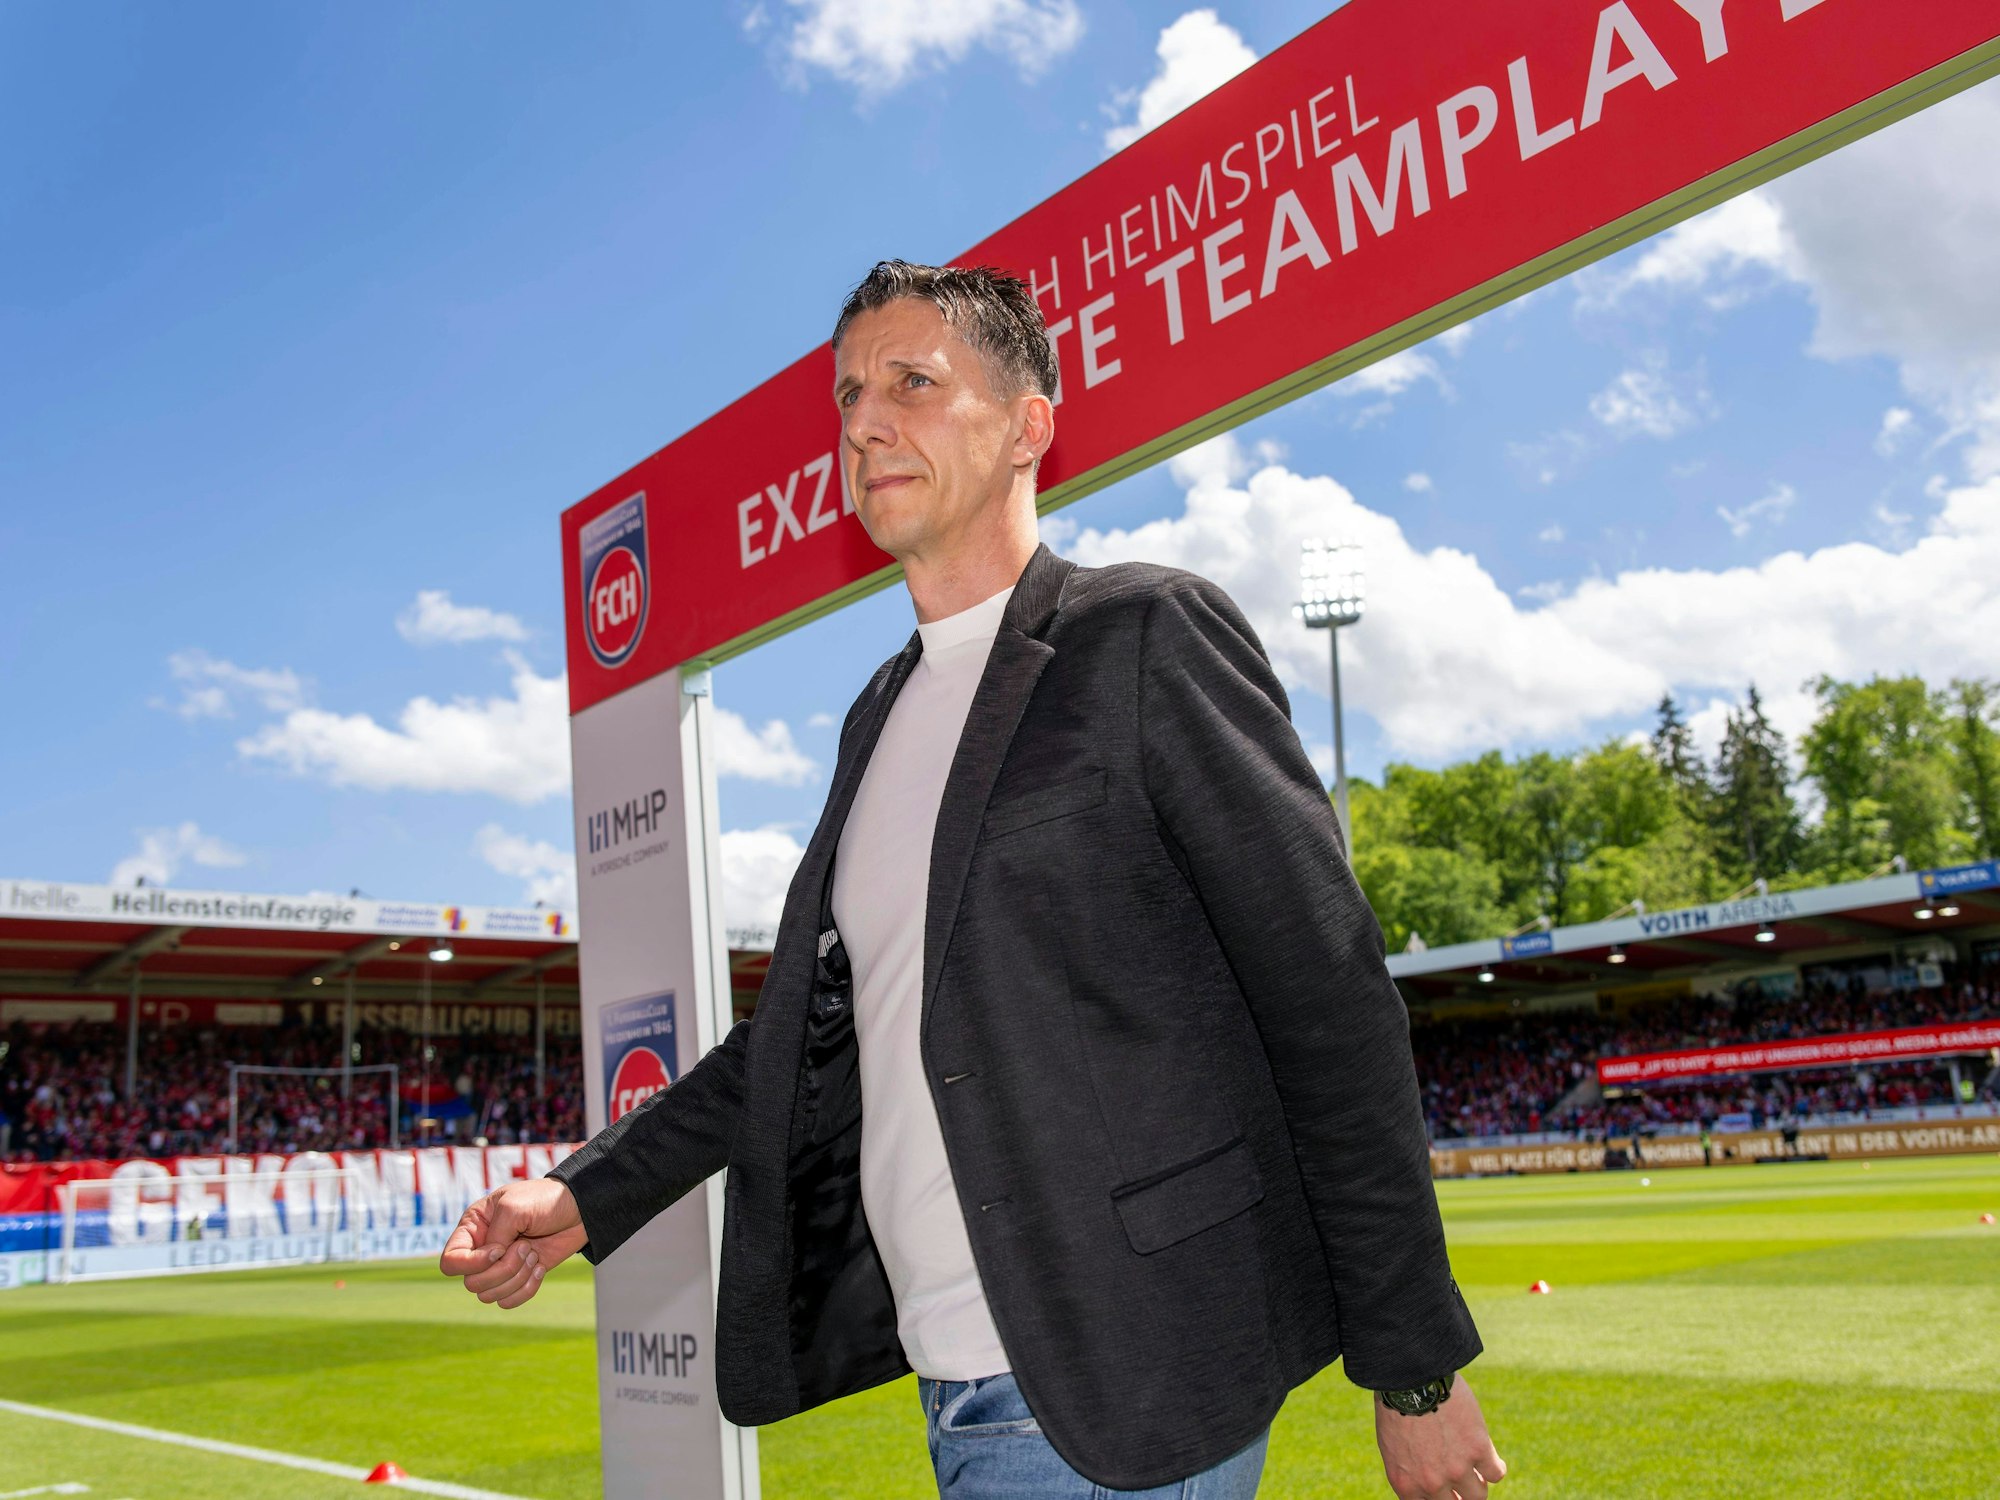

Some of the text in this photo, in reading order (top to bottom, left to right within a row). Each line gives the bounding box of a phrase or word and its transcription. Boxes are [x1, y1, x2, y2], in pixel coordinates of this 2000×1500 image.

[1082, 74, 1380, 292] HEIMSPIEL
[1144, 0, 1829, 346] TEAMPLAY
[596, 570, 638, 634] FCH
[612, 788, 668, 846] MHP
[598, 853, 632, 875] PORSCHE
[633, 840, 670, 863] COMPANY
[1938, 868, 1990, 887] VARTA
[112, 890, 356, 931] HellensteinEnergie
[1638, 894, 1797, 936] VOITH ARENA
[1469, 1154, 1500, 1173] VIEL
[1501, 1150, 1544, 1170] PLATZ
[1549, 1146, 1575, 1167] FÜR
[1644, 1138, 1726, 1161] MOMENE
[1835, 1132, 1857, 1153] IN
[1859, 1130, 1899, 1151] DER
[638, 1331, 698, 1379] MHP
